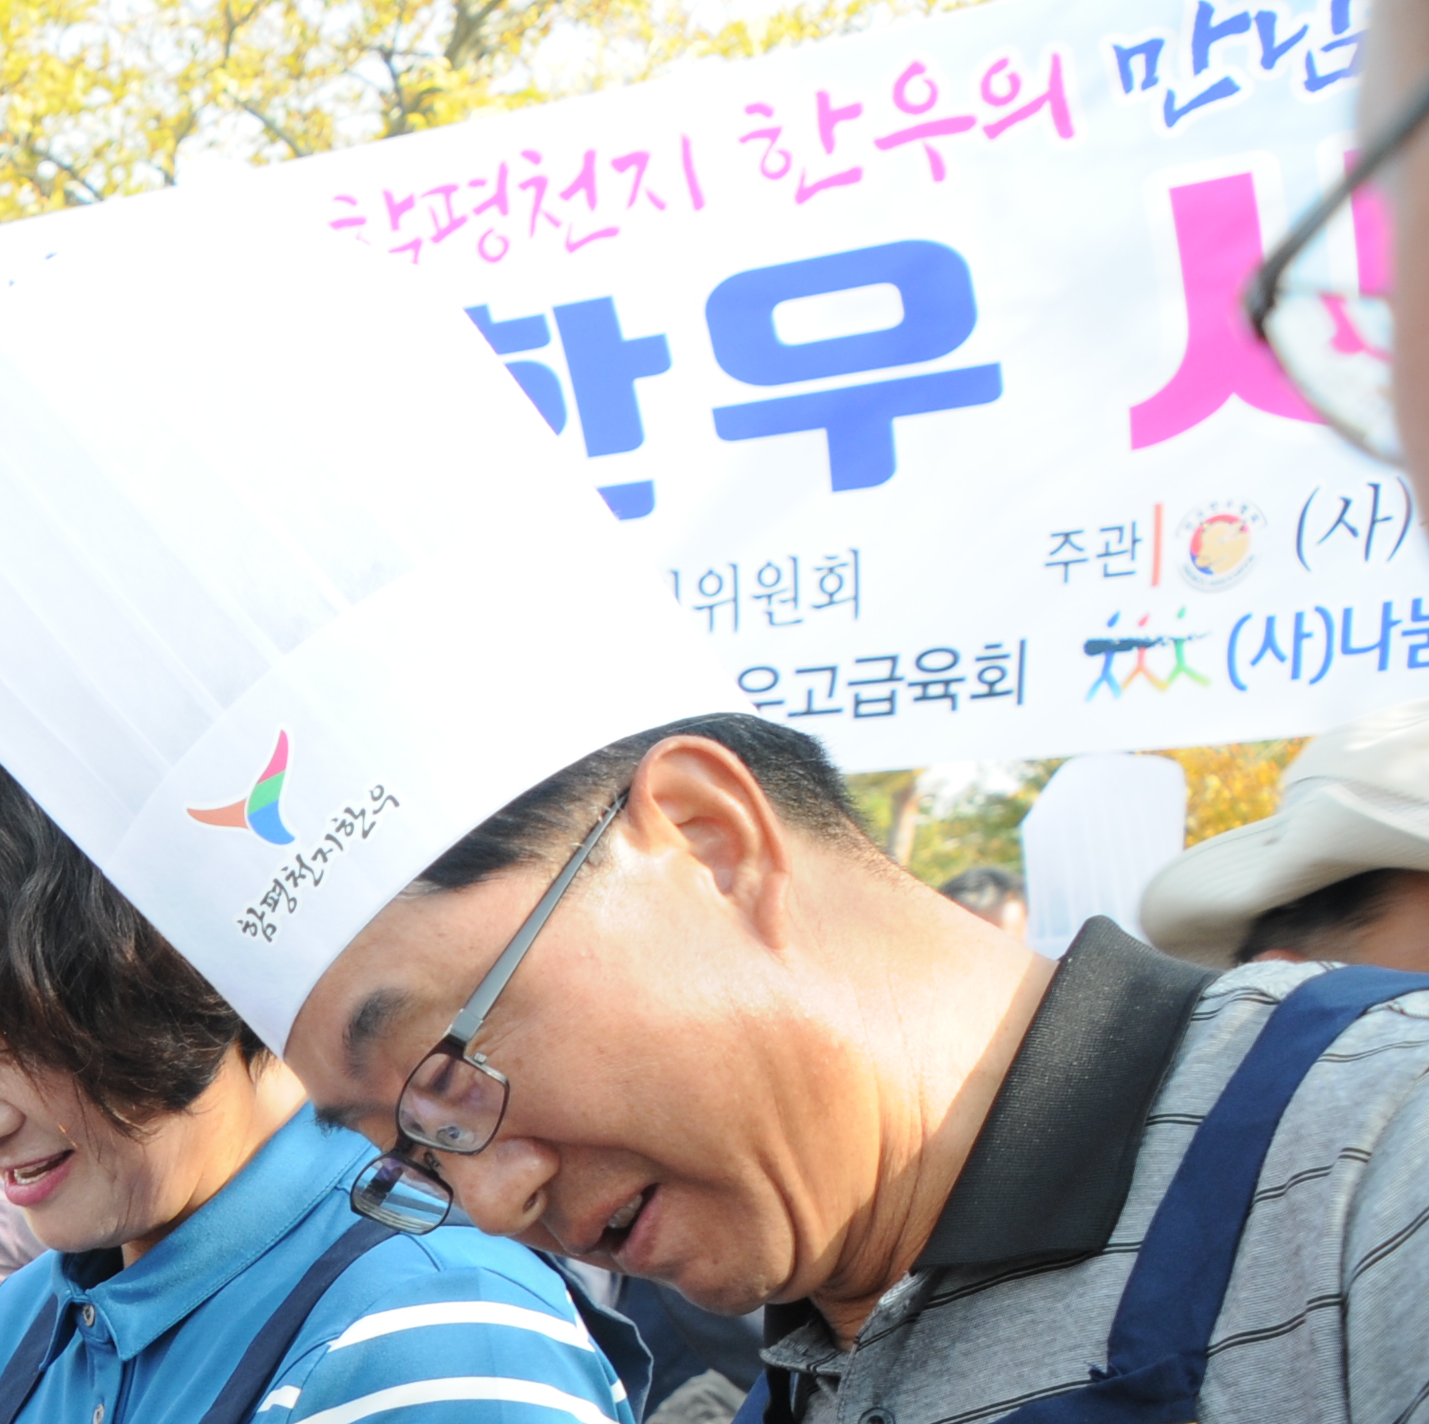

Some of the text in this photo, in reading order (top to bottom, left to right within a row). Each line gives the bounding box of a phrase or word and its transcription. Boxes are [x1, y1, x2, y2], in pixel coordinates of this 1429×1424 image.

[739, 53, 1075, 205] 한우의
[669, 547, 860, 635] 위원회
[1044, 520, 1143, 584] 주관
[1296, 475, 1413, 573] (사)
[237, 783, 401, 943] 함평천지한우
